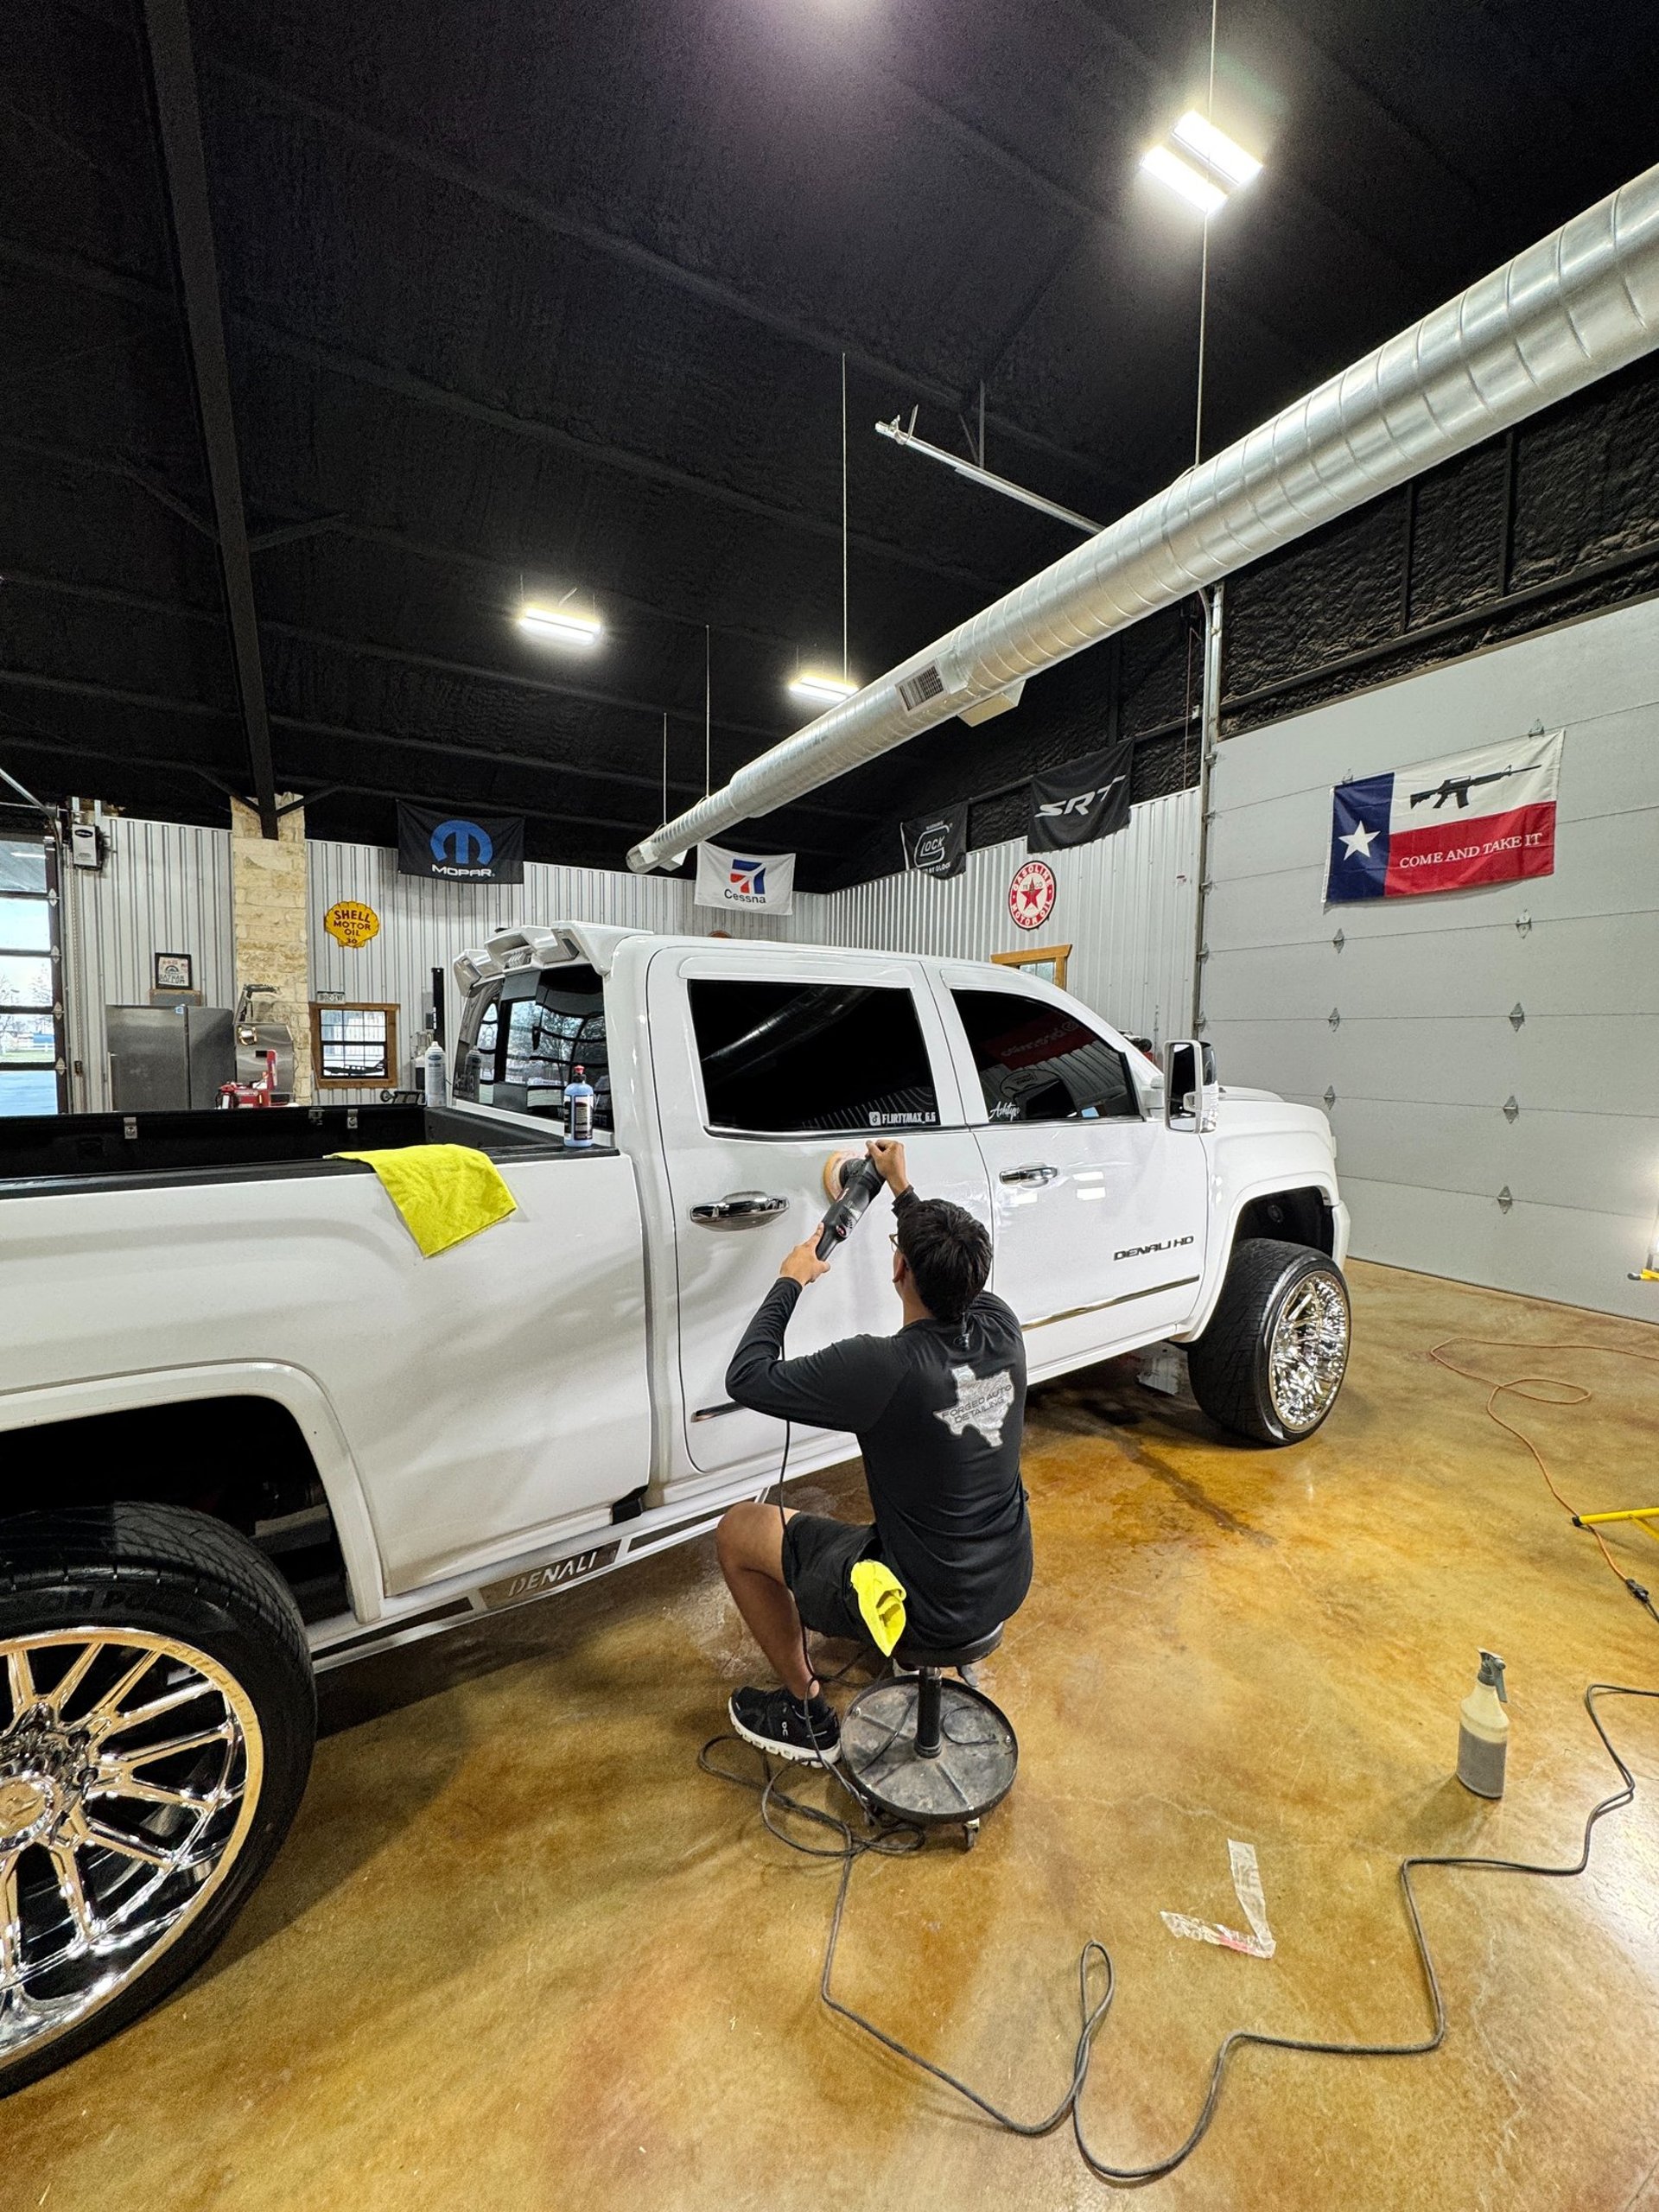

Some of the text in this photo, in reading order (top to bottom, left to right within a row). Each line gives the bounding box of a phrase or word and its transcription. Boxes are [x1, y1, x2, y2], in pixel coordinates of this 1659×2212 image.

[1034, 775, 1126, 817] SRT
[1399, 833, 1543, 868] COME AND TAKE IT
[431, 864, 492, 877] MOPAR
[1013, 865, 1052, 891] GASOLINE
[724, 888, 766, 904] Cessna
[334, 910, 371, 923] SHELL
[1011, 899, 1052, 925] MOTOR OIL
[334, 920, 371, 931] MOTOR
[344, 928, 360, 937] OIL
[1113, 1236, 1194, 1261] DENALI HD
[942, 1384, 1012, 1418] FORGED AUTO
[954, 1397, 1005, 1423] DETAILING
[508, 1551, 597, 1598] DENALI
